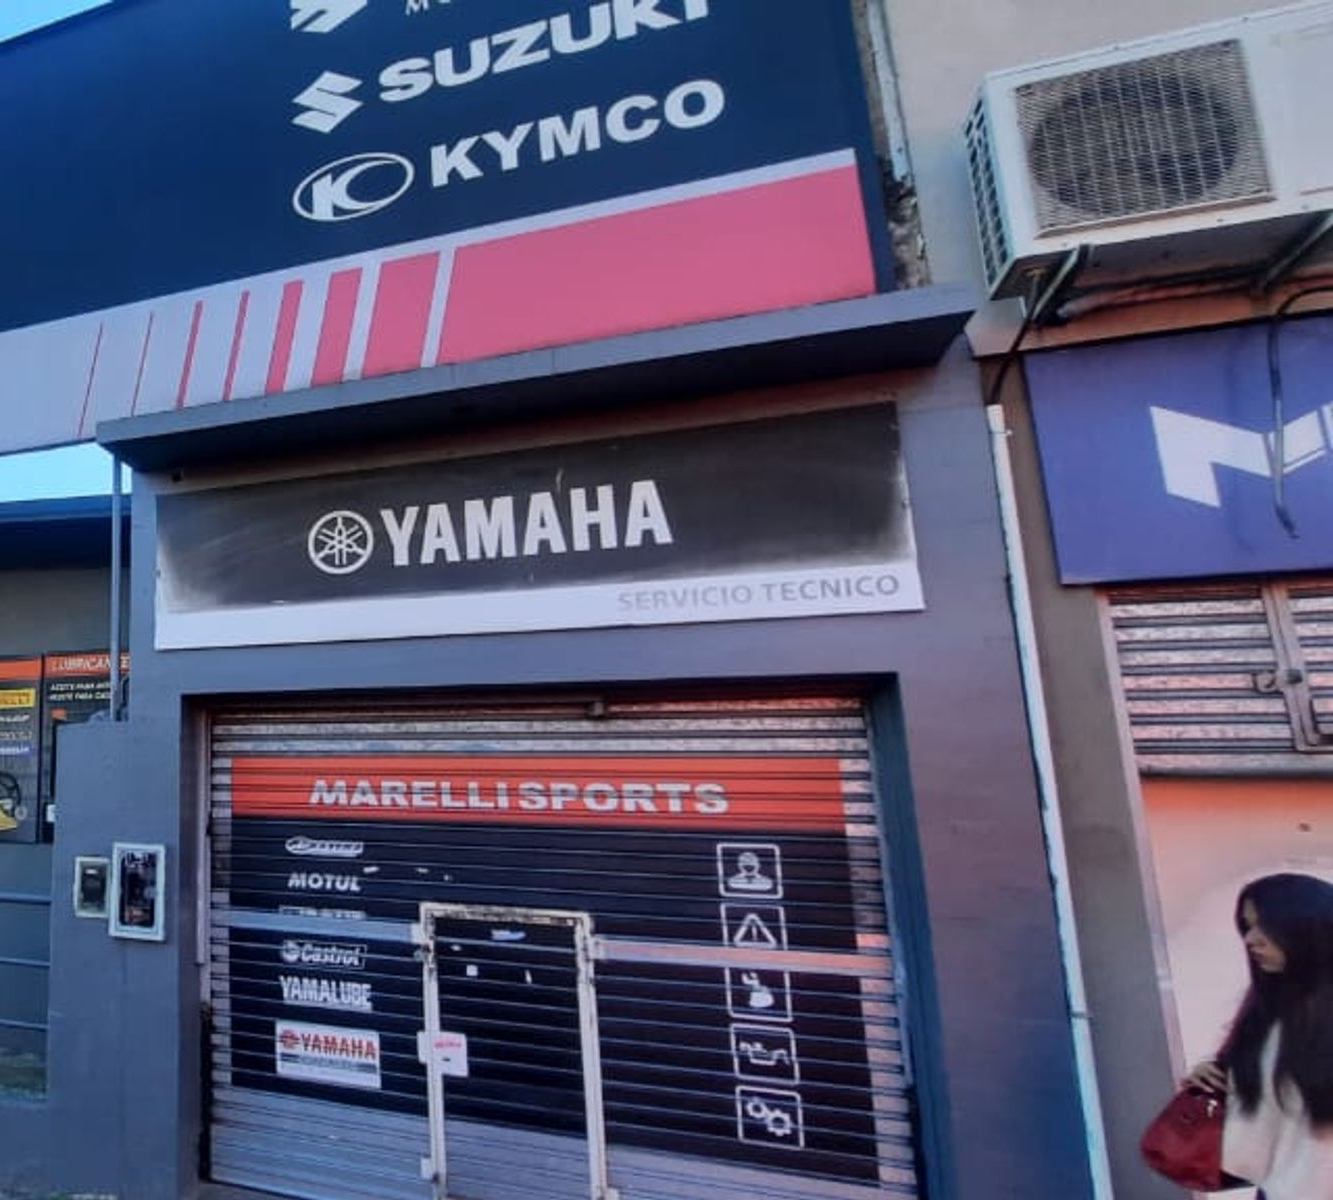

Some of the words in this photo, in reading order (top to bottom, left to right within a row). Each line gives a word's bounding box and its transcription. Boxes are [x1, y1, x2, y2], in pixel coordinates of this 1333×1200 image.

[430, 80, 725, 187] KYMCO
[381, 479, 674, 567] YAMAHA
[618, 585, 752, 611] SERVICIO
[761, 575, 899, 602] TECNICO
[288, 873, 361, 892] MOTUL
[301, 943, 360, 966] Castrol
[279, 975, 372, 1009] YAMALUBE
[301, 1033, 376, 1060] YAMAHA
